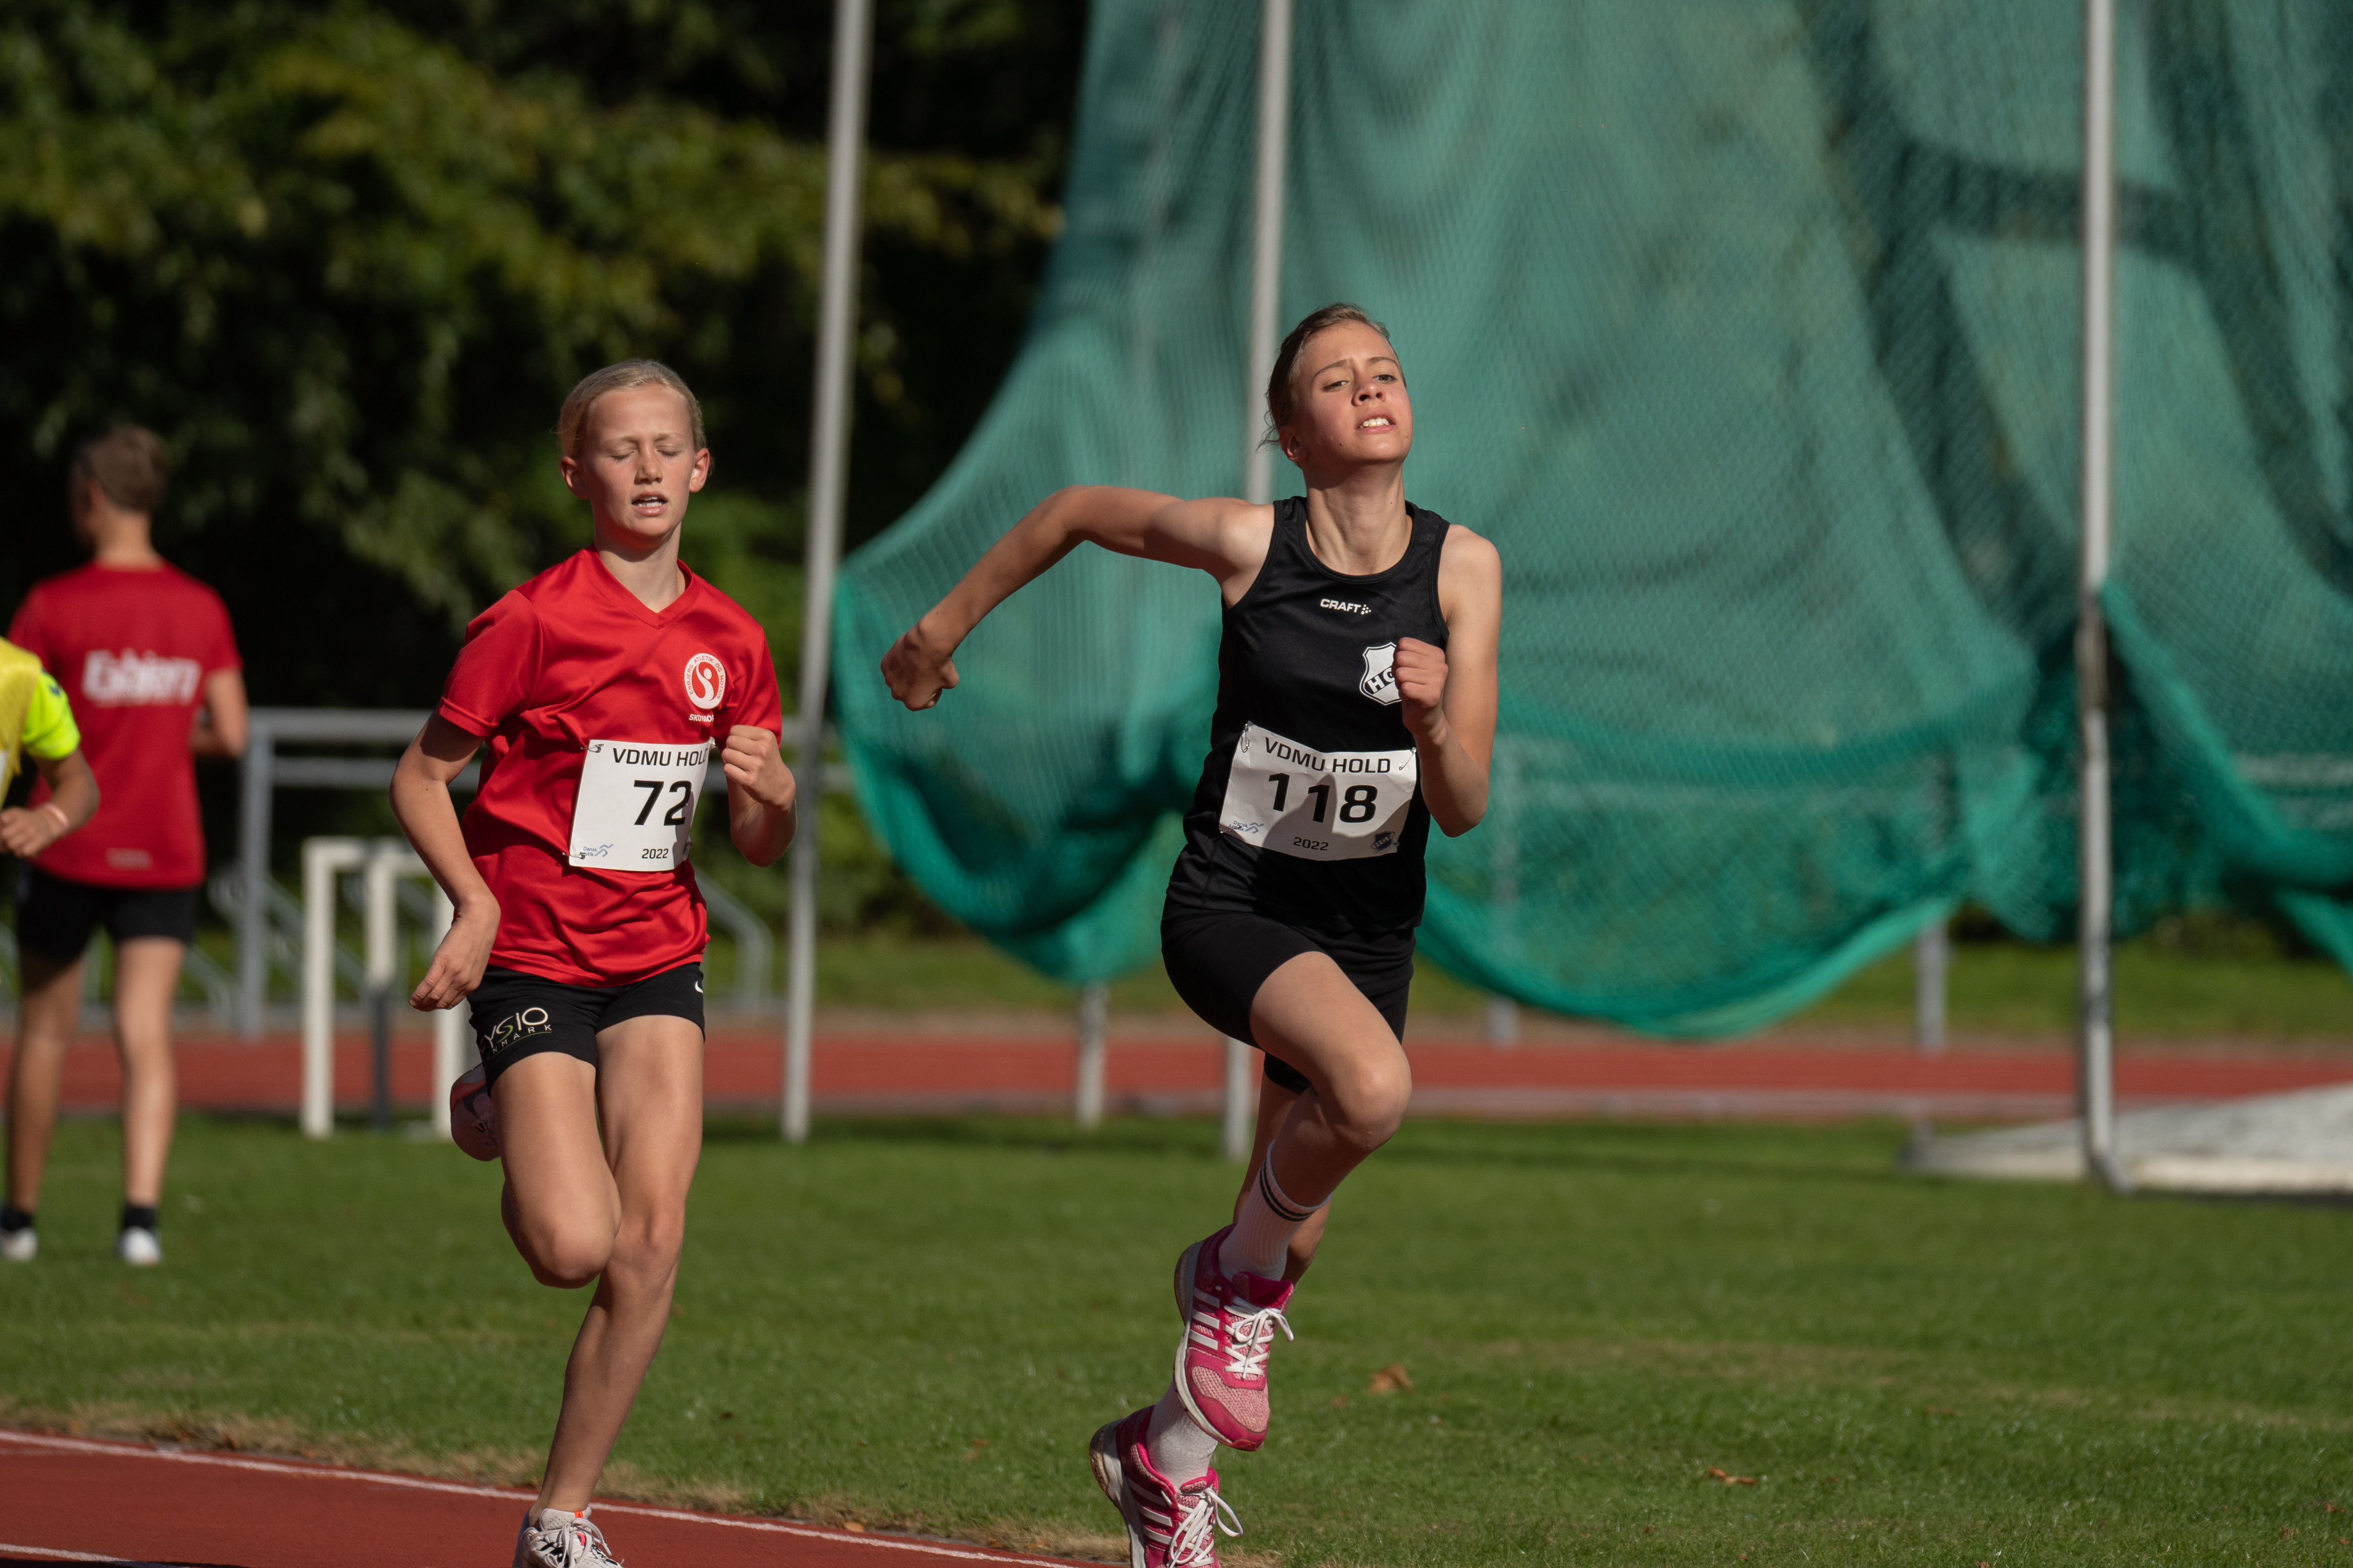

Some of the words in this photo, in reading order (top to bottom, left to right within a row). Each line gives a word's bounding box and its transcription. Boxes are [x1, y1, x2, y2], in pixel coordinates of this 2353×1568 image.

[1320, 598, 1361, 613] CRAFT
[694, 655, 714, 664] ATLETIK
[715, 663, 722, 673] OG
[1367, 667, 1395, 693] HG
[613, 747, 672, 767] VDMU
[676, 747, 708, 767] HOLD
[1265, 737, 1326, 772] VDMU
[1332, 758, 1391, 773] HOLD
[633, 780, 692, 826] 72
[1268, 772, 1378, 824] 118
[641, 848, 669, 859] 2022
[1293, 836, 1330, 851] 2022
